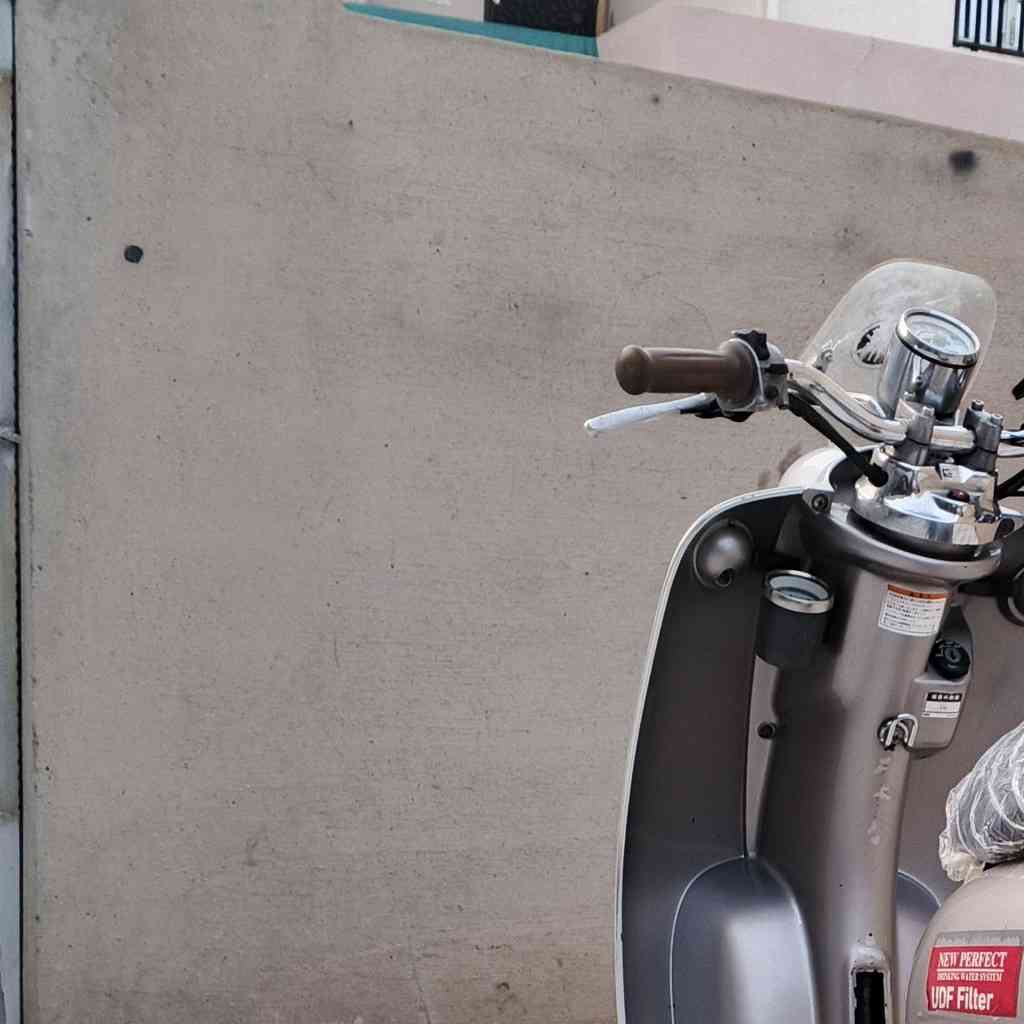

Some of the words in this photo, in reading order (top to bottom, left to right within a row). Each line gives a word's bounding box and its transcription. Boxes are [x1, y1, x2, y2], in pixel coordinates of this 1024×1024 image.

[938, 951, 959, 967] NEW
[959, 951, 1008, 968] PERFECT
[931, 985, 955, 1009] UDF
[957, 985, 994, 1011] Filter
